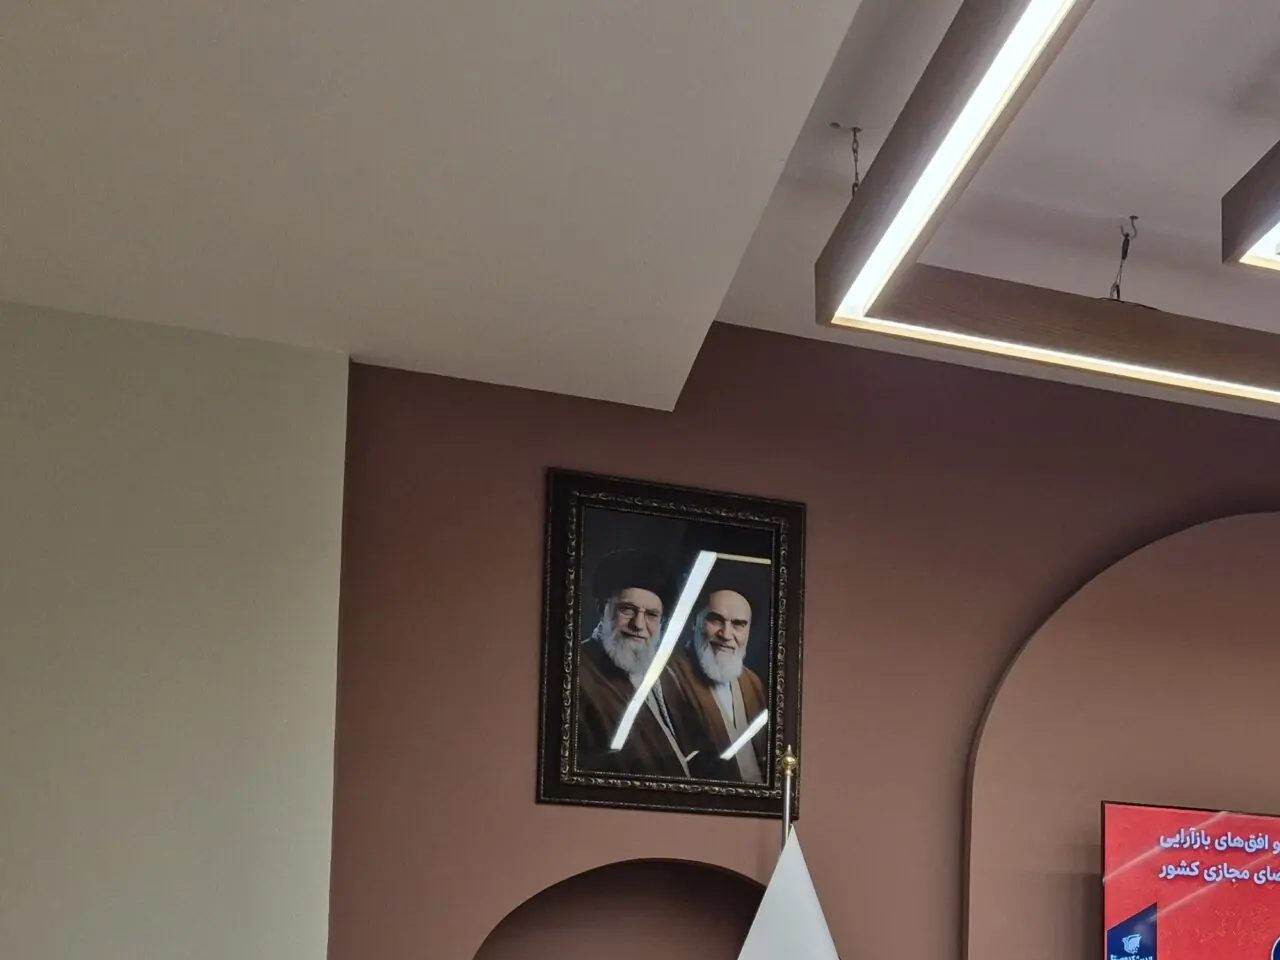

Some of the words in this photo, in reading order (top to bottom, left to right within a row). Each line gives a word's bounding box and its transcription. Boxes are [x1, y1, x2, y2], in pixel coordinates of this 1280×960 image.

[1160, 828, 1211, 848] بازآرایی
[1272, 842, 1280, 855] و
[1159, 860, 1200, 878] کشور
[1203, 863, 1249, 882] مجازی
